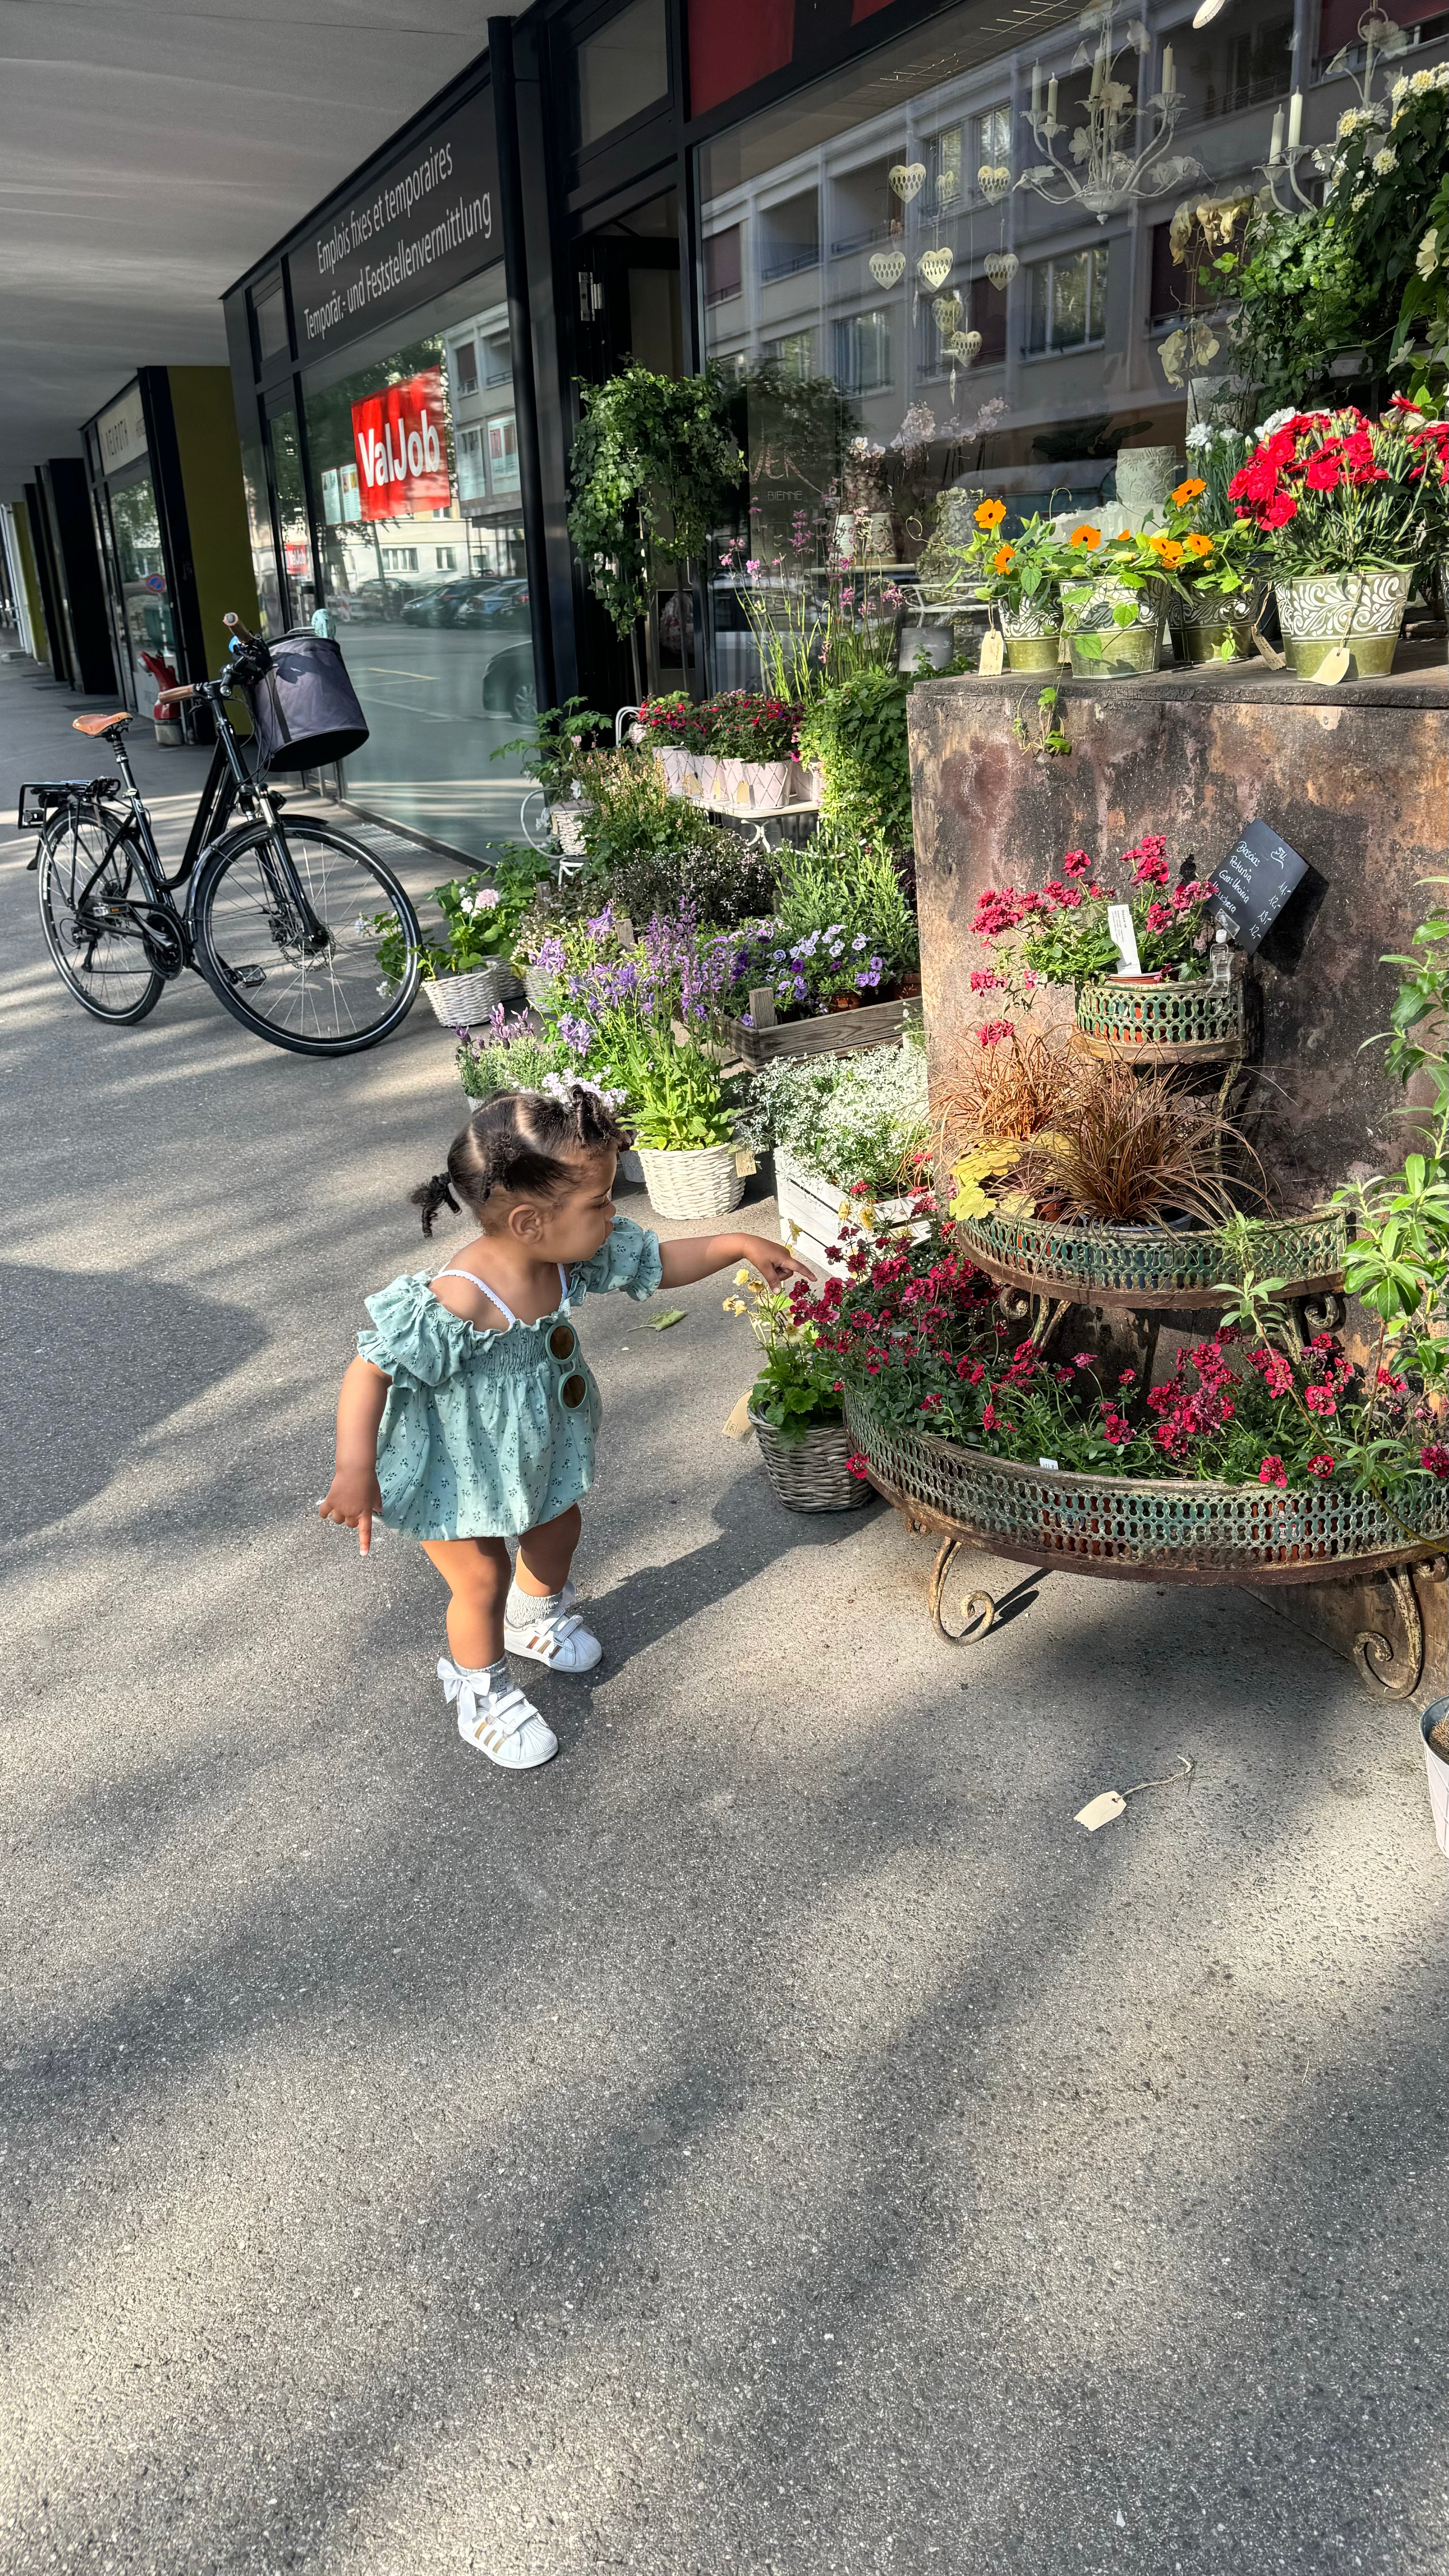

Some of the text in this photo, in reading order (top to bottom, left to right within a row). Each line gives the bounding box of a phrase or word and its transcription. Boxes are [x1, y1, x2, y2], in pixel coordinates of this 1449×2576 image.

[317, 143, 452, 274] Emplois fixes et temporaires
[347, 268, 365, 313] und
[365, 192, 491, 302] Feststellenvermittlung
[358, 409, 440, 487] ValJob
[767, 491, 803, 501] BIENNE
[1219, 870, 1233, 884] Gras
[1230, 856, 1252, 883] Petunia
